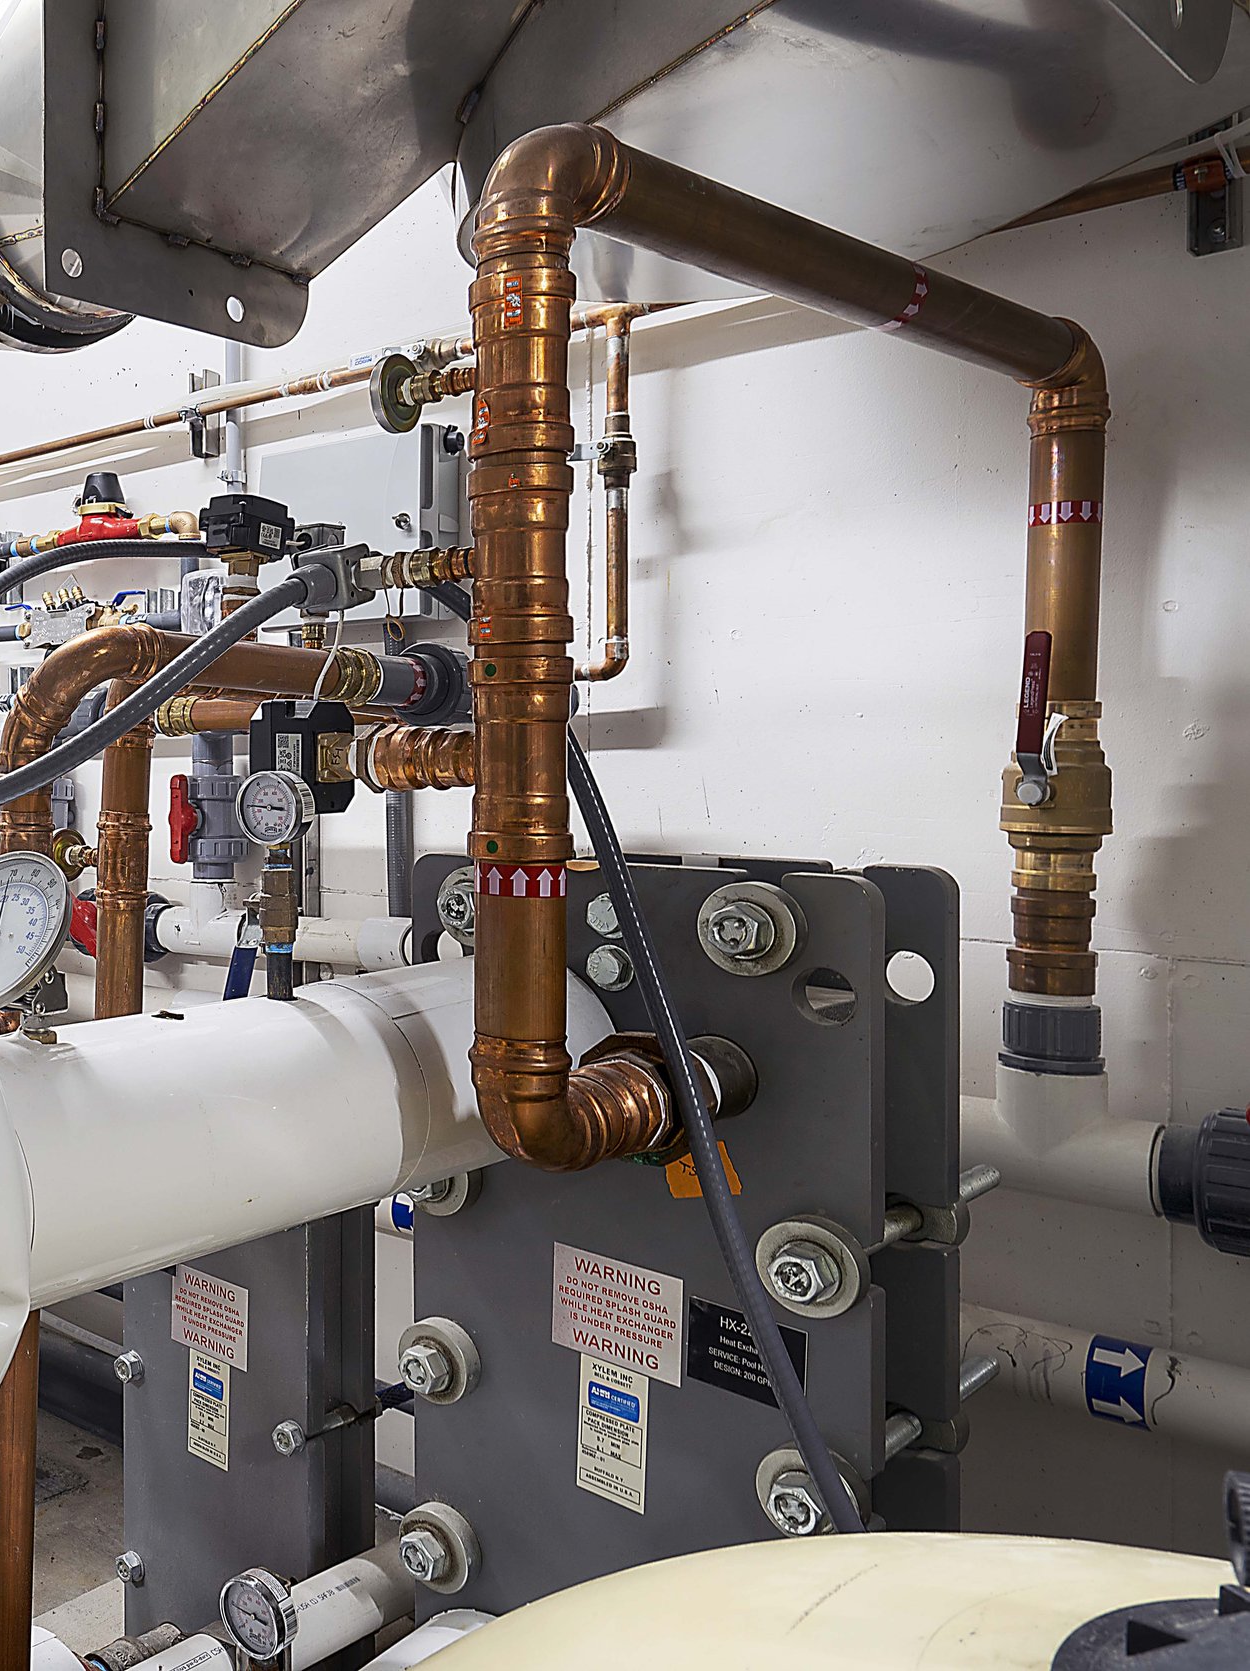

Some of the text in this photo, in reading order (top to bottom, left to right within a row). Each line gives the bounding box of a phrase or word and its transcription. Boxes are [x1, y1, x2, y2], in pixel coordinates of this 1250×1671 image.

[1023, 676, 1031, 709] LEGEND
[11, 893, 21, 902] 25
[20, 898, 30, 906] 30
[26, 906, 36, 915] 35
[28, 918, 38, 927] 40
[25, 931, 35, 940] 45
[679, 1160, 697, 1176] TS
[184, 1272, 236, 1302] WARNING
[574, 1256, 661, 1296] WARNING
[179, 1287, 240, 1317] DO NOT REMOVE OSHA
[558, 1284, 676, 1329] REQUIRED SPLASH GUARD
[566, 1275, 668, 1315] DO NOT REMOVE OSHA
[175, 1294, 245, 1328] REQUIRED SPLASH GUARD
[175, 1304, 243, 1337] WHILE HEAT EXCHANGER
[560, 1296, 674, 1341] WHILE HEAT EXCHANGER
[188, 1318, 207, 1331] UNDER
[207, 1325, 237, 1343] PRESSURE
[570, 1311, 663, 1349] IS UNDER PRESSURE
[183, 1327, 235, 1360] WARNING
[573, 1327, 659, 1370] WARNING
[719, 1335, 759, 1355] Heat Excha
[708, 1346, 741, 1364] SERVICE:
[742, 1357, 757, 1370] Pool
[592, 1362, 633, 1384] XYLEM INC
[713, 1360, 743, 1377] DESIGN:
[743, 1371, 756, 1382] 200
[585, 1409, 619, 1428] COMPRESSED
[619, 1421, 635, 1434] PLATE
[587, 1416, 600, 1428] PACK
[601, 1422, 629, 1438] DIMENSION
[610, 1441, 620, 1450] MIN
[610, 1450, 621, 1460] MAX
